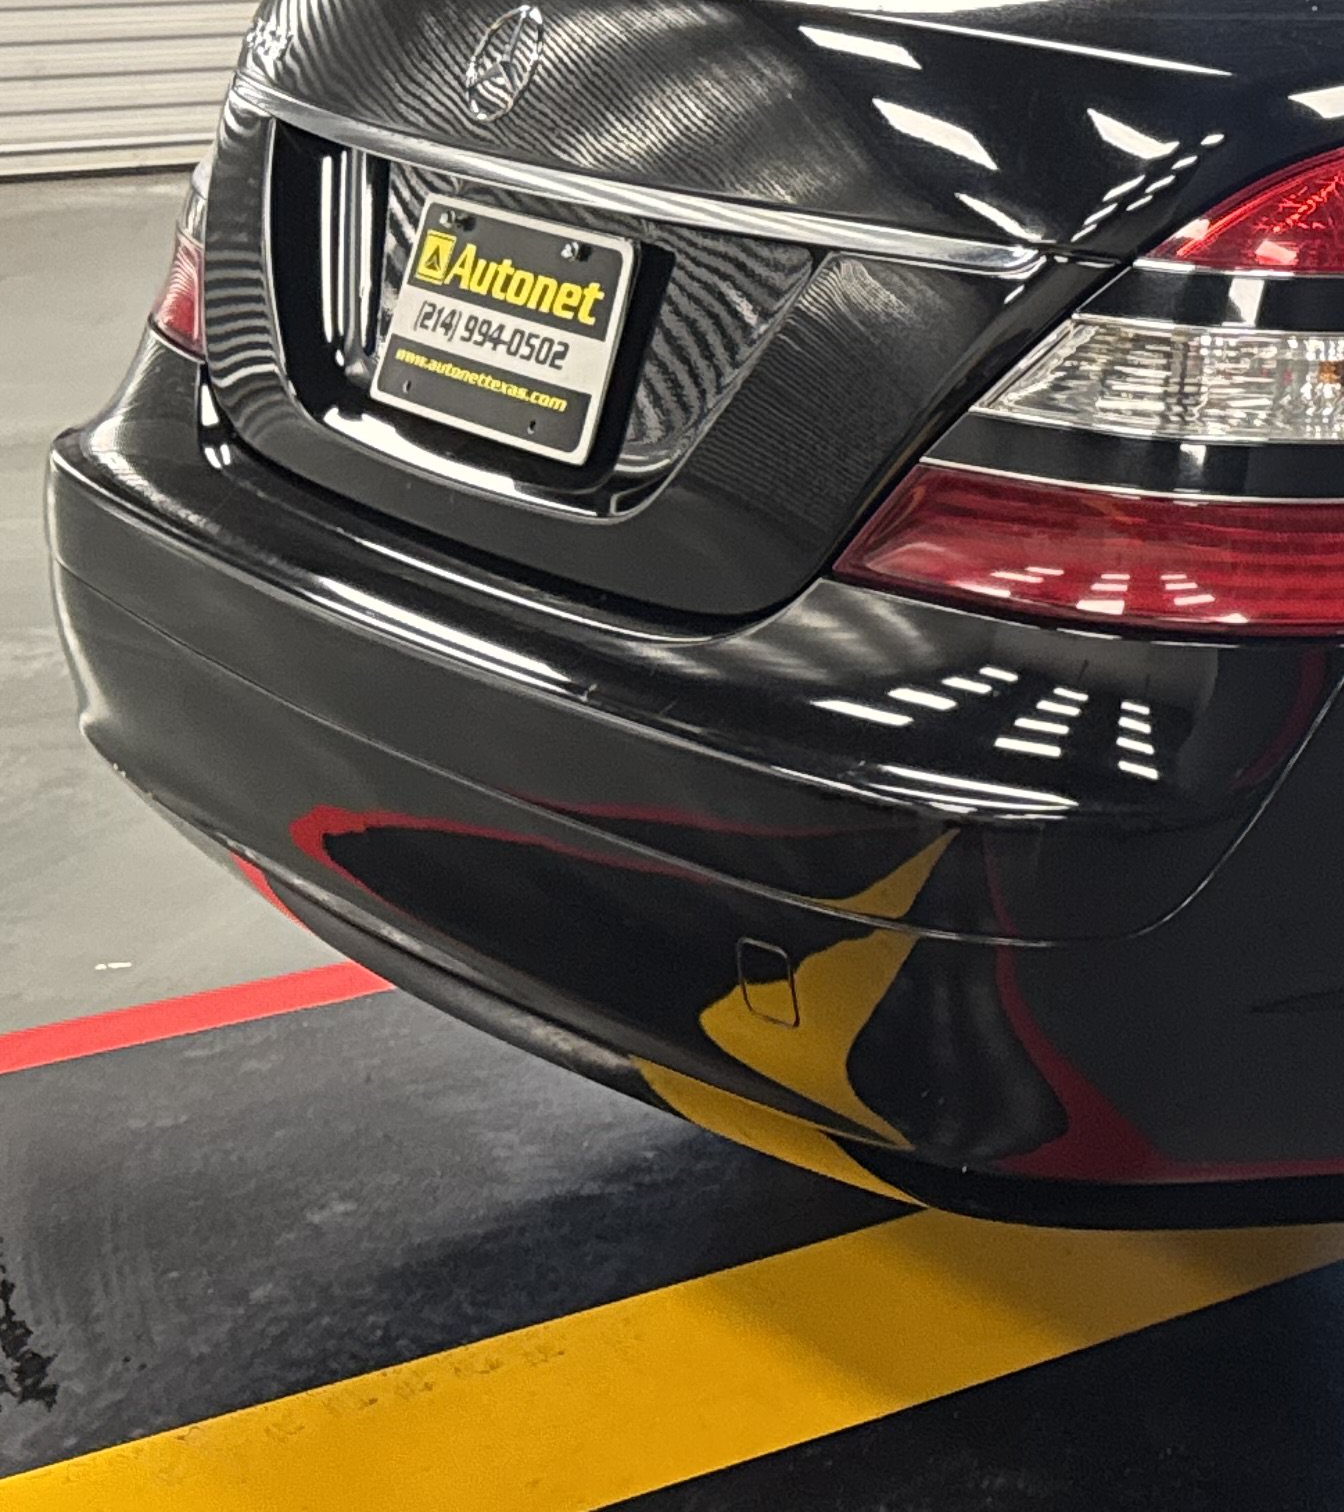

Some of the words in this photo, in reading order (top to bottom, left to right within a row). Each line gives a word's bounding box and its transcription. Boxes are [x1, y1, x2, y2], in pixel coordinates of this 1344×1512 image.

[444, 244, 605, 325] Autonet
[413, 300, 462, 342] (214)
[460, 314, 570, 370] 994-0502
[395, 349, 568, 412] www.autonettexas.com
